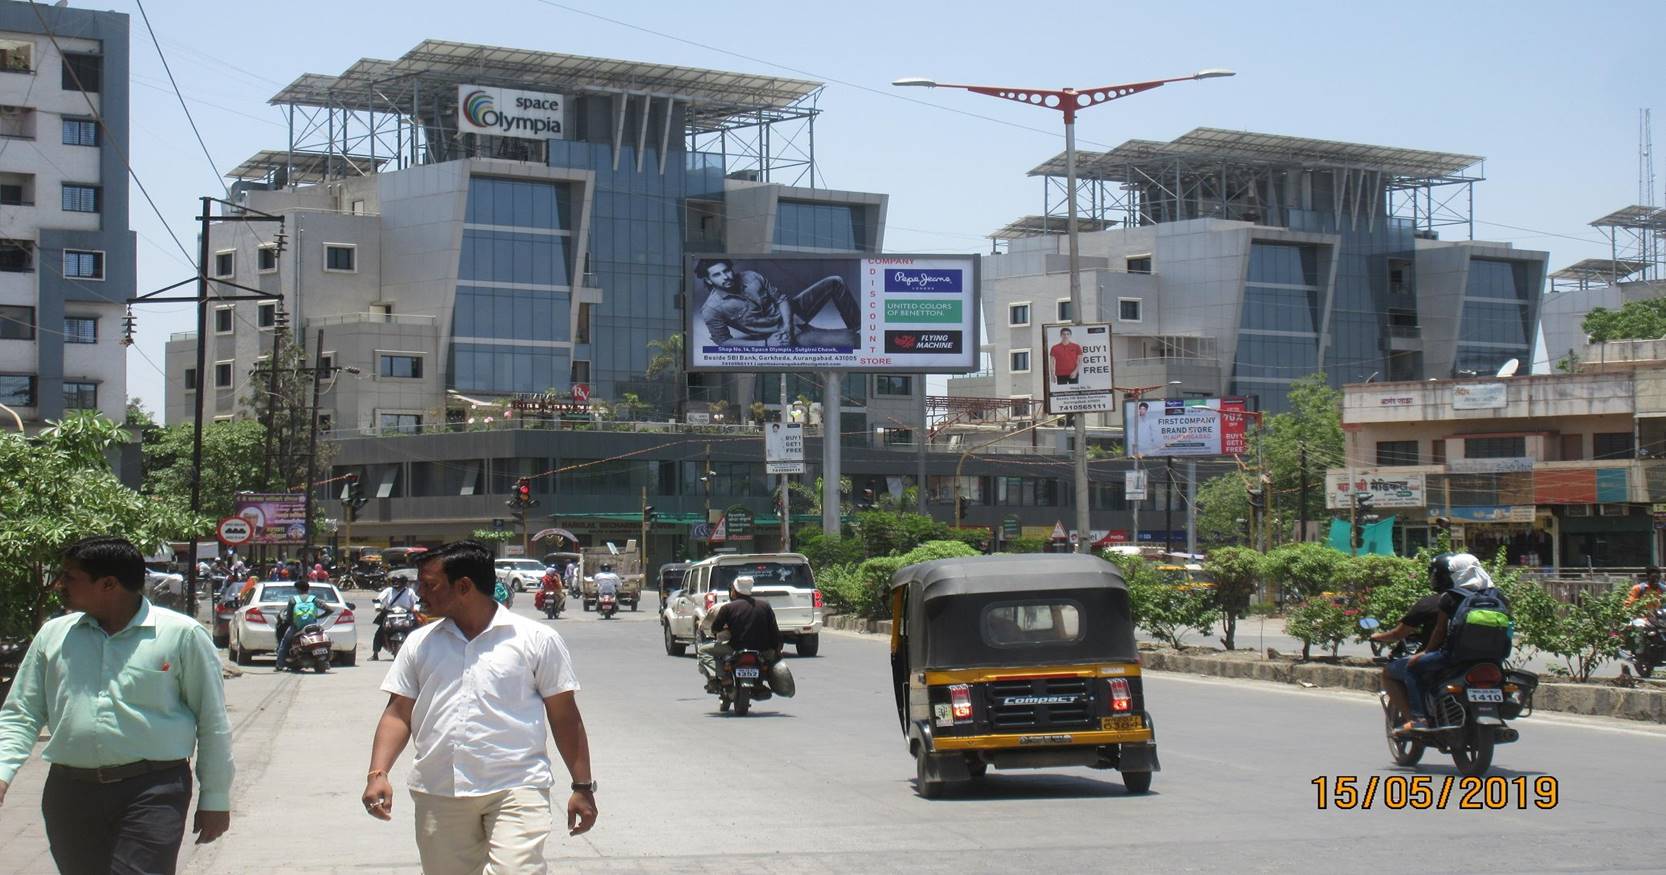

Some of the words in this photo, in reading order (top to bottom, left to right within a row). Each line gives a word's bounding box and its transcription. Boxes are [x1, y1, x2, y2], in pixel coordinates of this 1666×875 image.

[516, 97, 560, 110] space
[482, 110, 561, 135] Olympia
[868, 256, 914, 265] COMPANY
[894, 271, 919, 286] Pepe
[920, 272, 952, 286] Jeans
[920, 334, 949, 342] FLYING
[1082, 345, 1102, 354] BUY
[860, 357, 892, 365] STORE
[1083, 355, 1101, 364] GET
[1084, 365, 1110, 374] FREE
[1158, 417, 1179, 425] FIRST
[1179, 416, 1216, 425] COMPANY
[1161, 426, 1187, 434] BRAND
